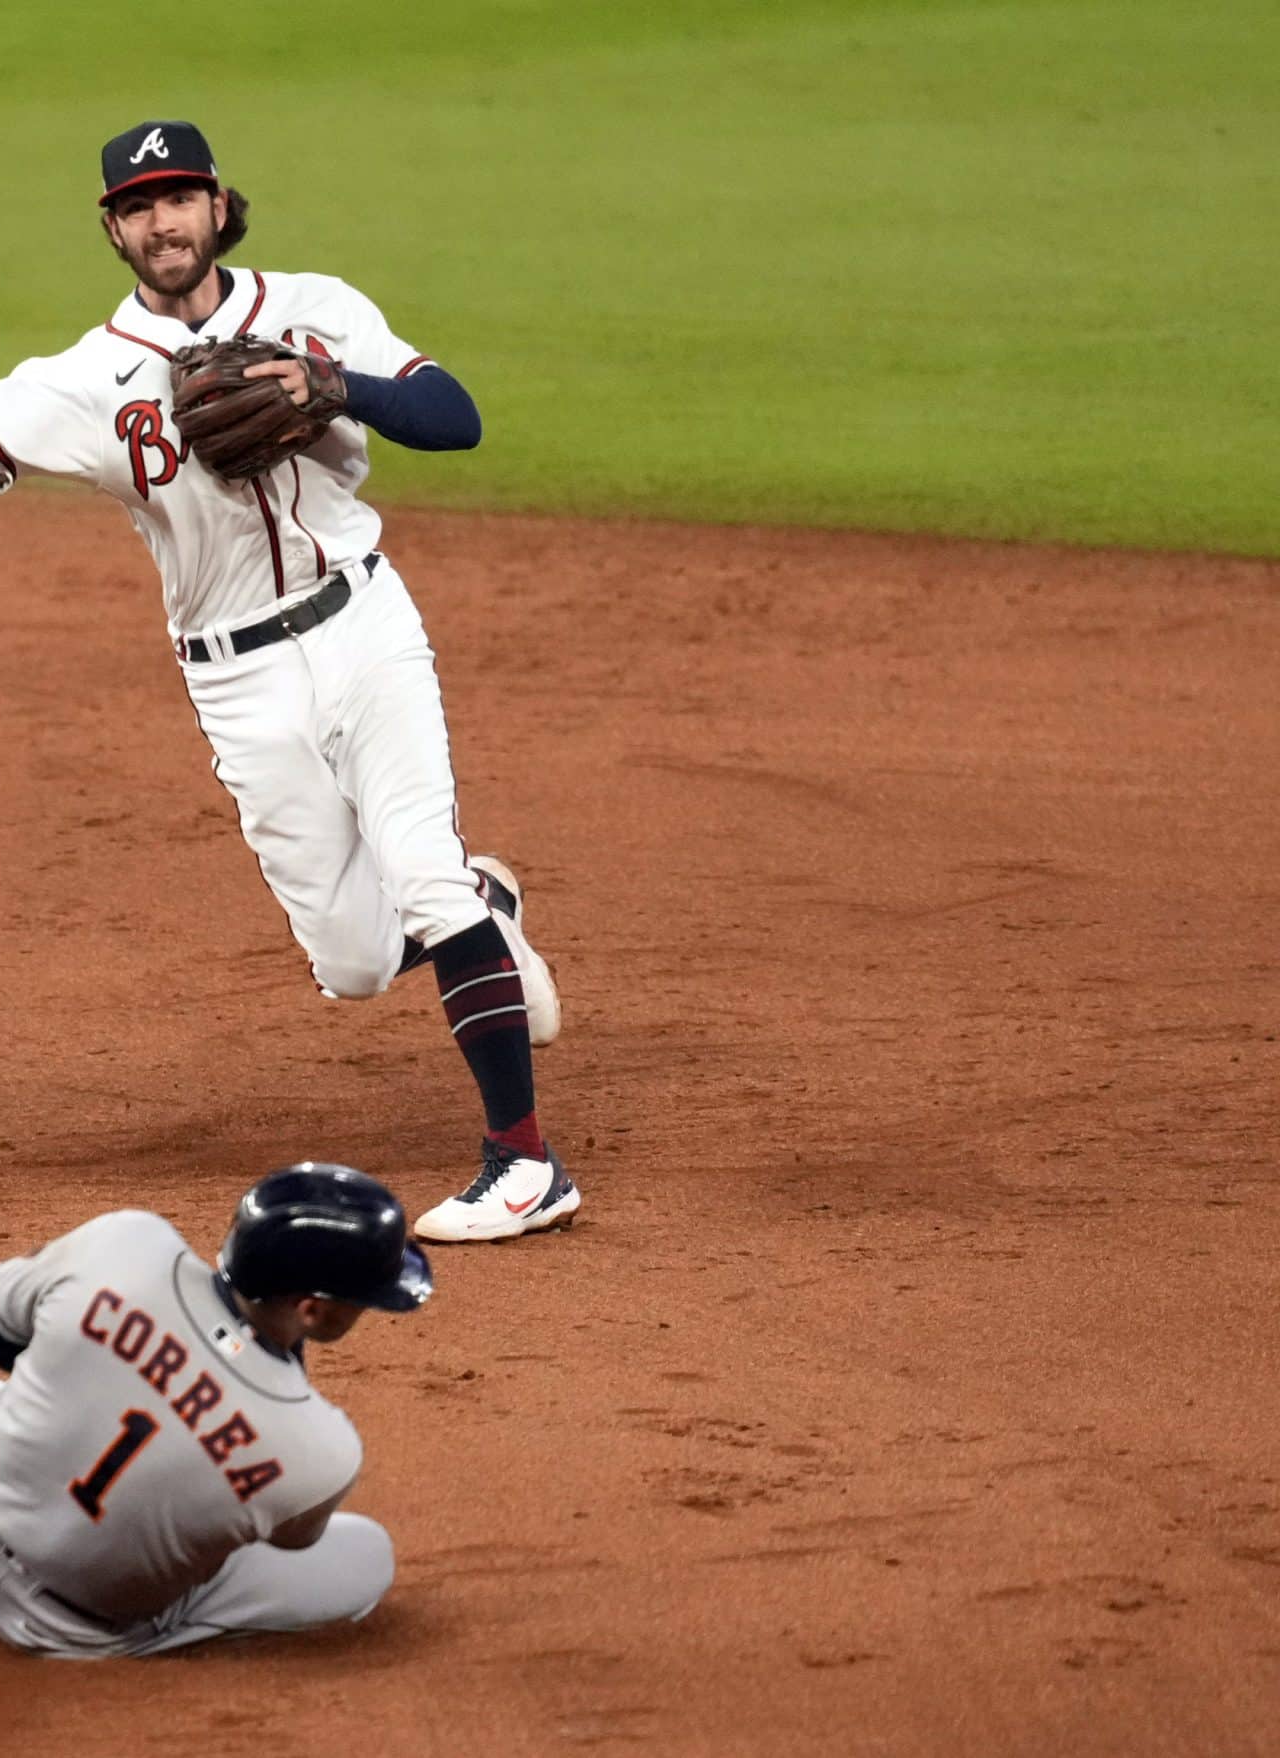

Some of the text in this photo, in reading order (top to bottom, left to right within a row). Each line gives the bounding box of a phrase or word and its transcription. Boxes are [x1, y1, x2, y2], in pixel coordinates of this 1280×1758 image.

[129, 127, 169, 164] A
[80, 1286, 283, 1503] CORREA
[68, 1406, 160, 1525] 1
